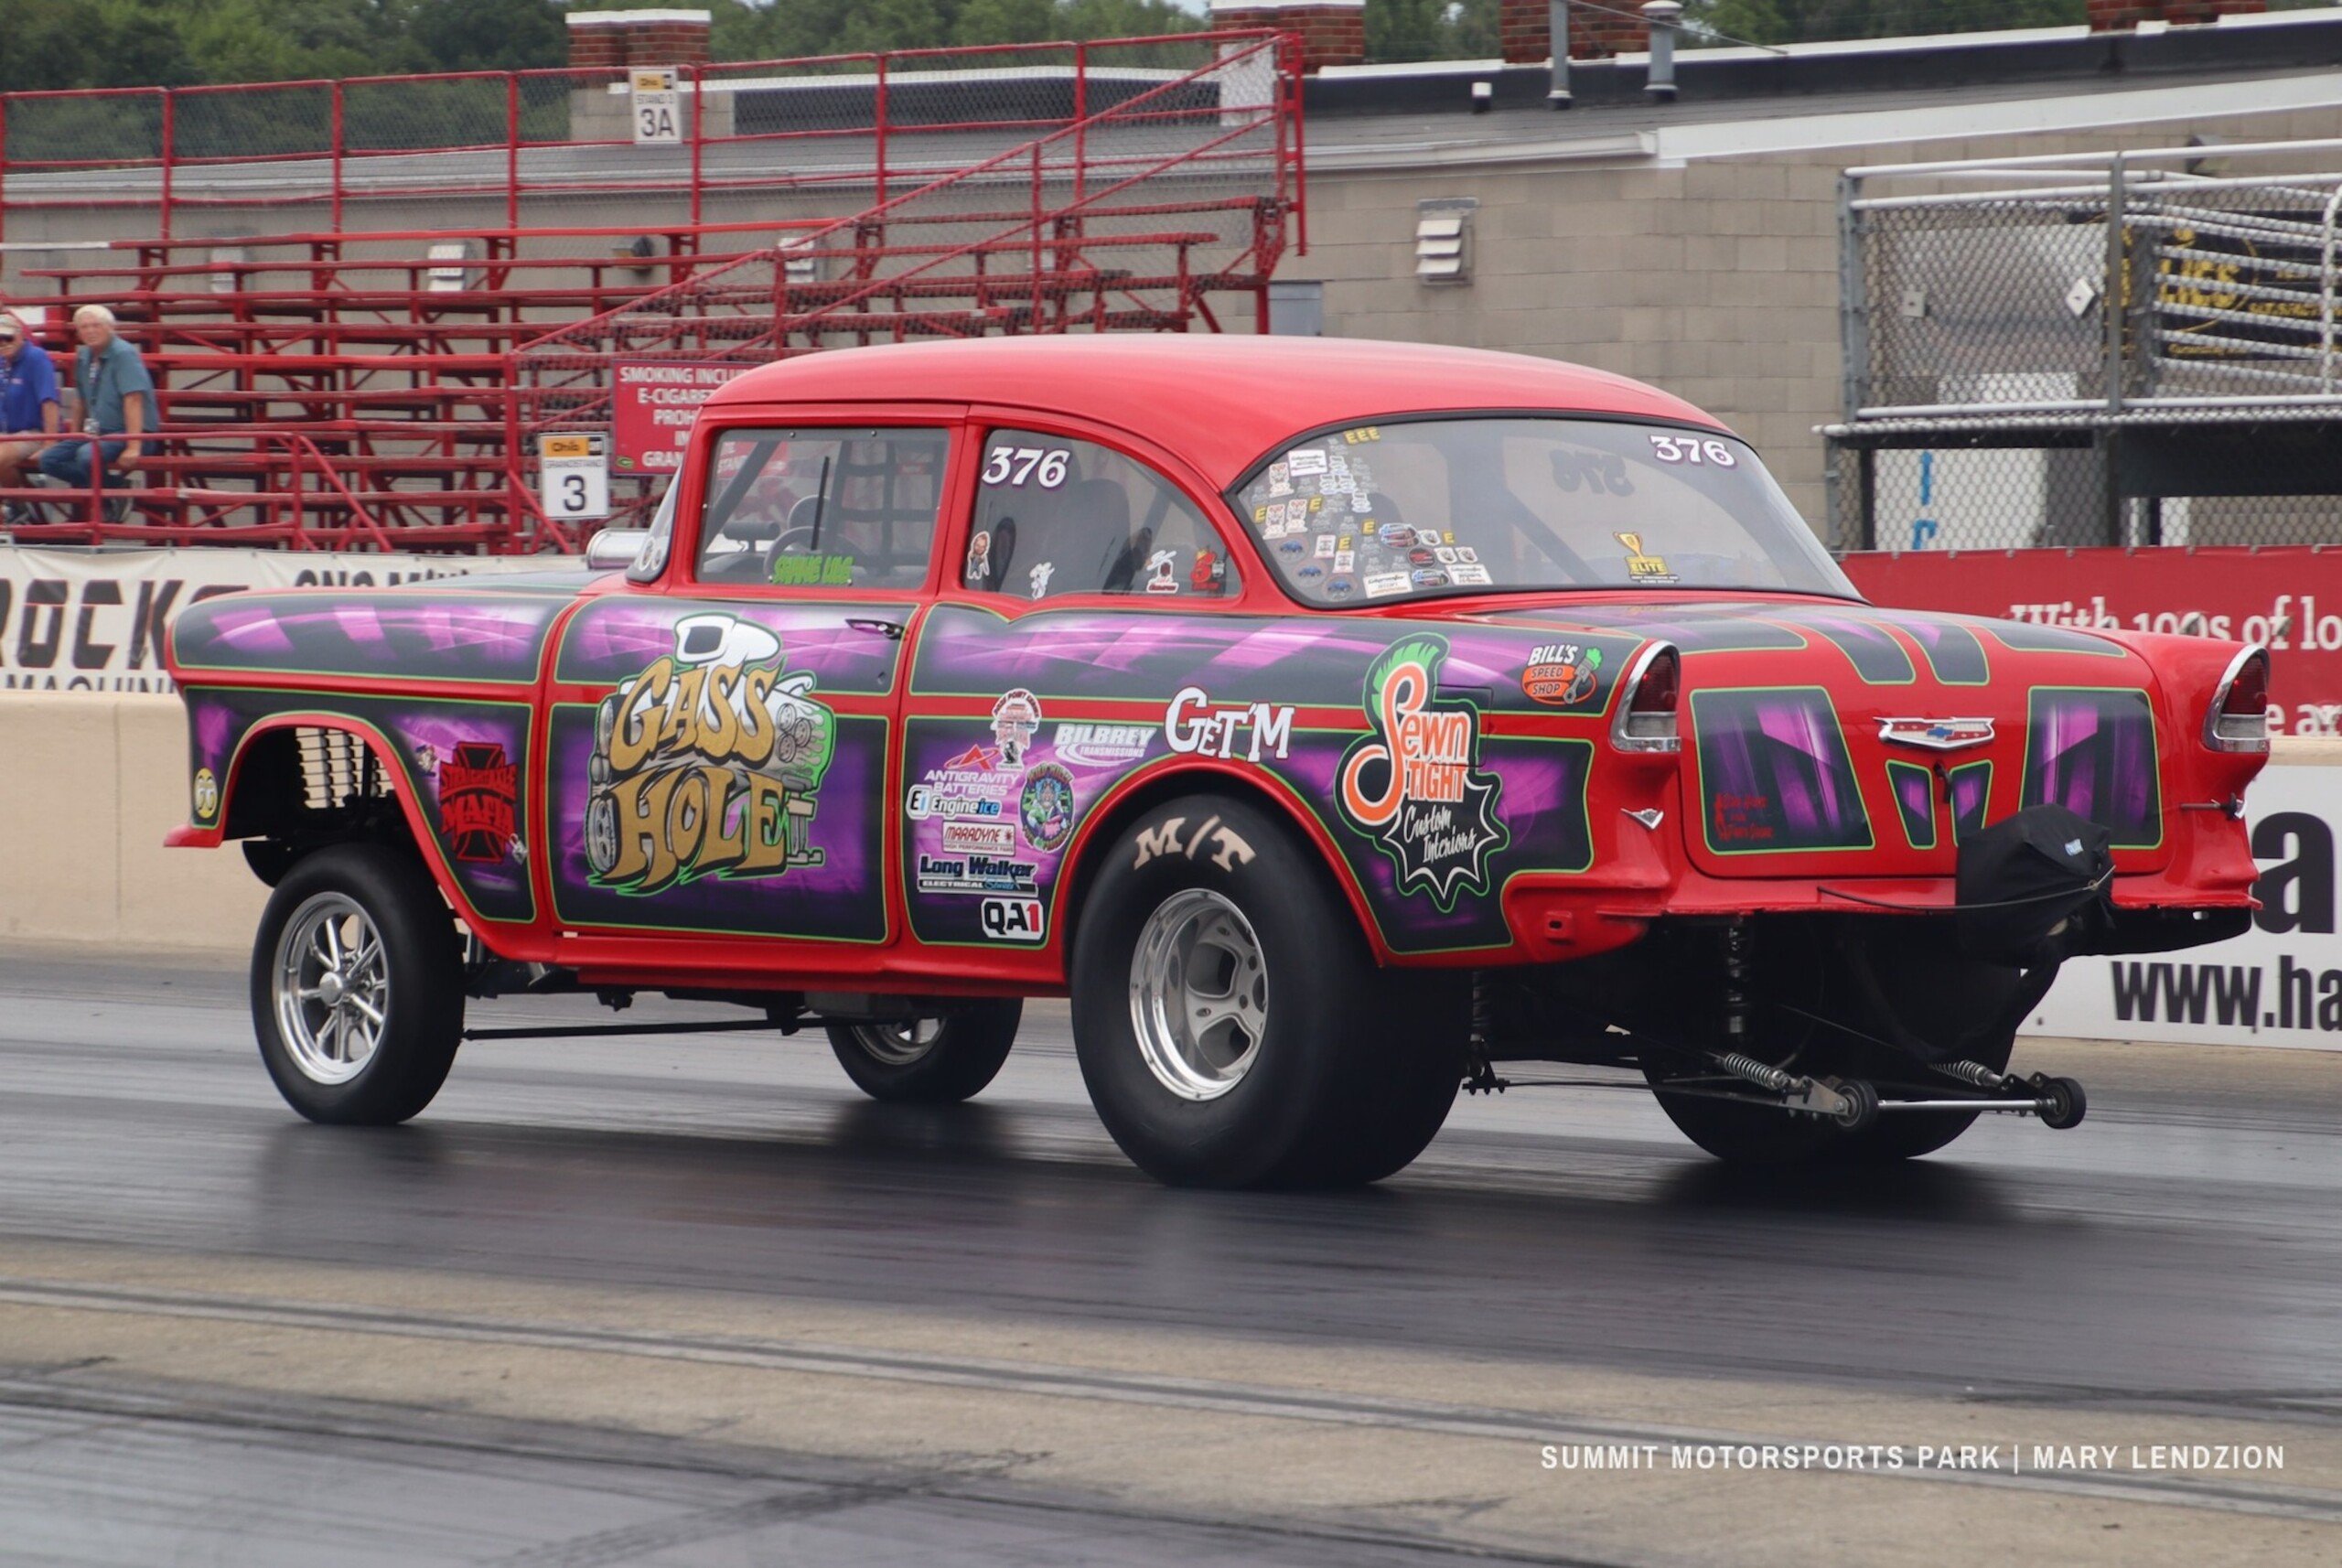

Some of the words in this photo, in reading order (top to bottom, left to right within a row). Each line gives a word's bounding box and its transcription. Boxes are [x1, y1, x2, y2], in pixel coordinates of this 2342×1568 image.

[640, 108, 675, 137] 3A
[619, 366, 694, 383] SMOKING
[1649, 435, 1736, 468] 376
[982, 446, 1071, 489] 376
[563, 474, 586, 511] 3
[1631, 562, 1668, 574] ELITE
[2242, 596, 2292, 650] of
[1527, 644, 1579, 666] BILL'S
[1531, 667, 1564, 678] SPEED
[1532, 682, 1561, 694] SHOP
[609, 658, 779, 772] GASS
[1054, 723, 1157, 746] BILBREY
[1080, 746, 1146, 758] TRANSMISSIONS
[924, 769, 1020, 784] ANTIGRAVITY
[933, 782, 1008, 796] BATTERIES
[1406, 761, 1470, 802] TIGHT
[441, 793, 515, 840] MAFIA
[601, 766, 788, 887] HOLE
[1403, 804, 1453, 843] Custom
[945, 826, 1002, 843] MARADYNE
[1133, 814, 1257, 874] M/T
[1423, 826, 1478, 865] Interiors
[920, 855, 964, 877] Long
[969, 856, 1036, 878] Walker
[922, 880, 983, 888] ELECTRICAL
[983, 900, 1040, 936] QA1
